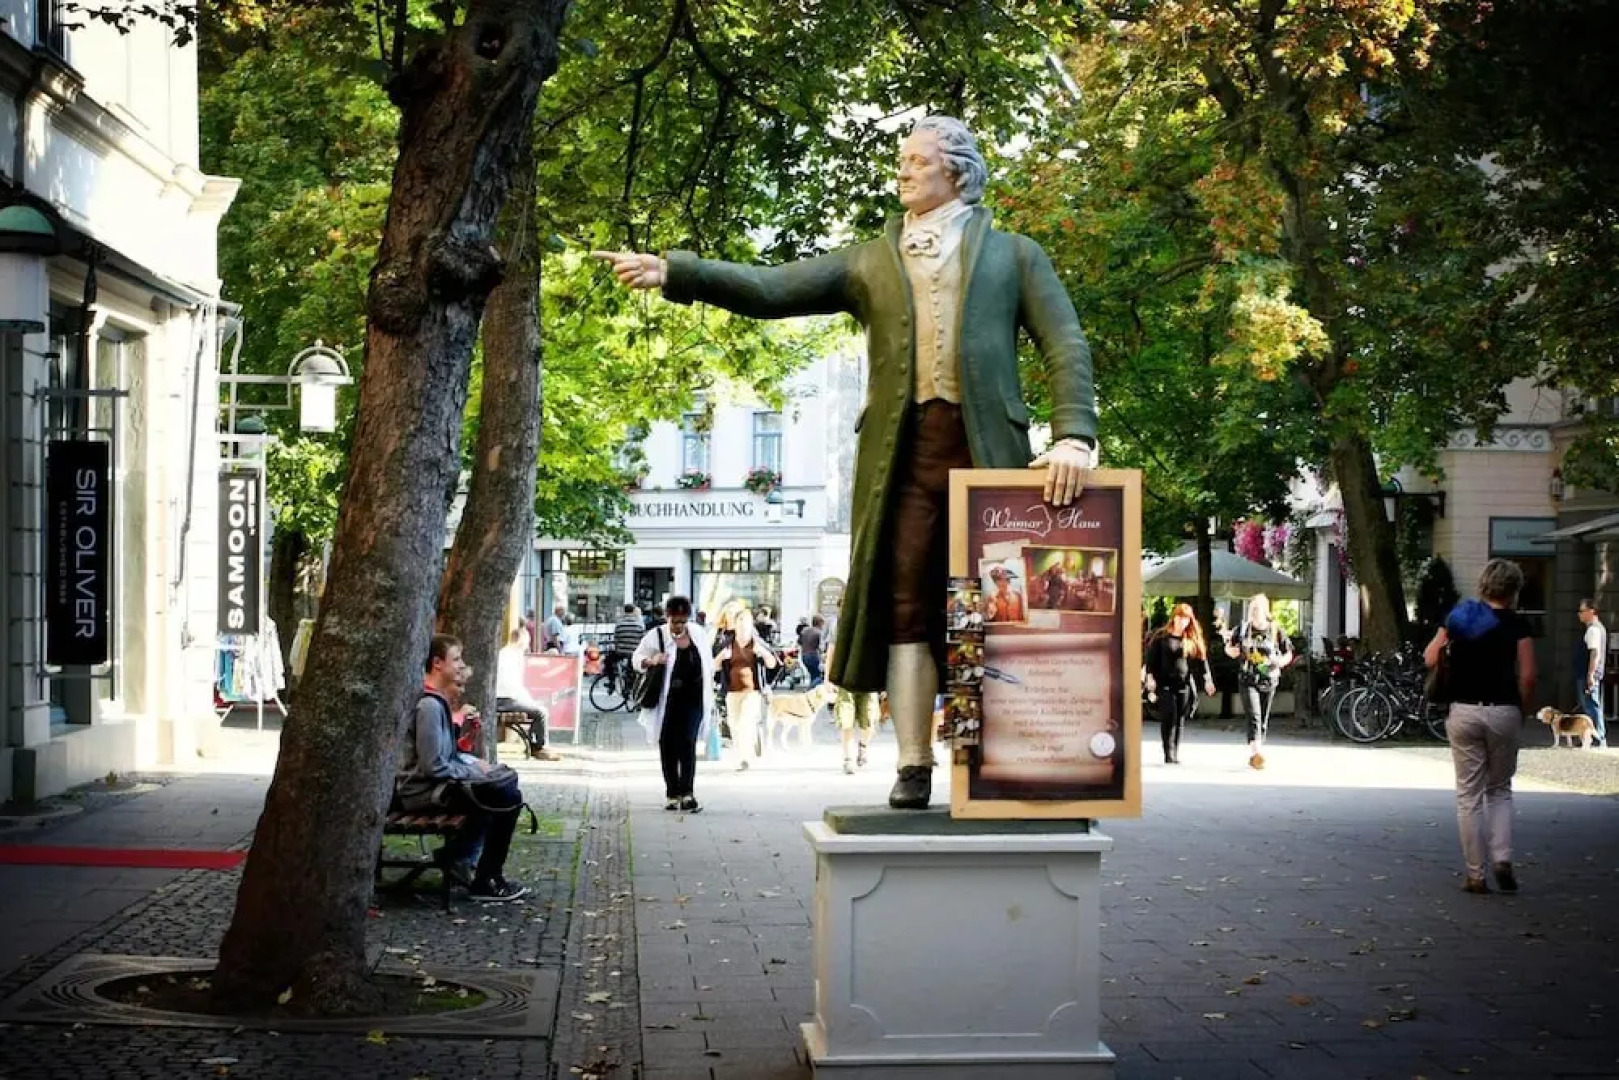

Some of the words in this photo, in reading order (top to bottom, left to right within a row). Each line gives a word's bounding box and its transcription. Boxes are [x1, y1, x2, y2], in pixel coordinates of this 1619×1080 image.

[75, 468, 96, 515] SIR
[629, 502, 754, 517] BUCHHANDLUNG
[983, 506, 1045, 530] Weimar
[1057, 507, 1101, 529] Haus
[227, 479, 245, 630] SAMOON
[75, 524, 96, 639] OLIVER
